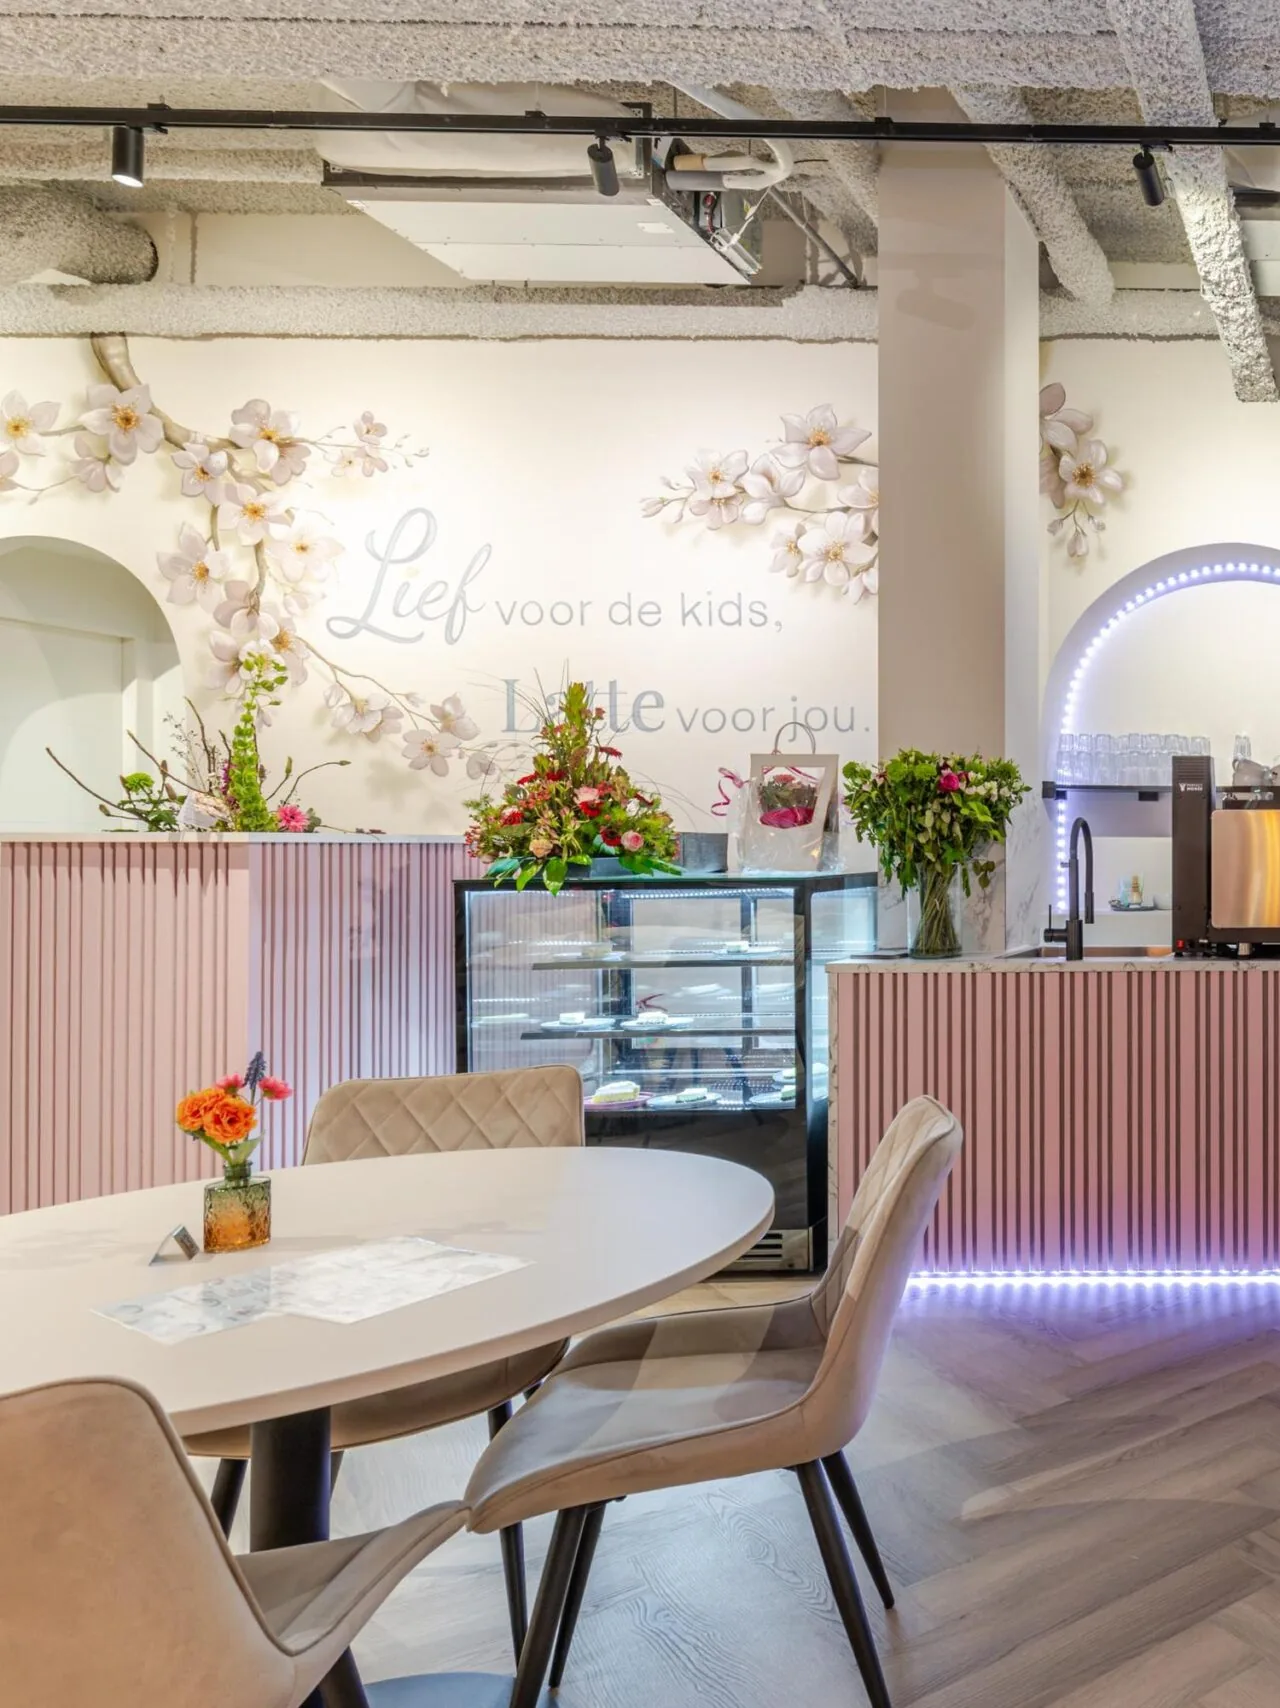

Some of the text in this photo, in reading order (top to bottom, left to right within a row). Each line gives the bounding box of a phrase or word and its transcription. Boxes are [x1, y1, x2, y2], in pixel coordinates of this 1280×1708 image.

[326, 506, 783, 645] Lief voor de kids,
[676, 704, 776, 734] voor
[787, 694, 871, 743] jou.
